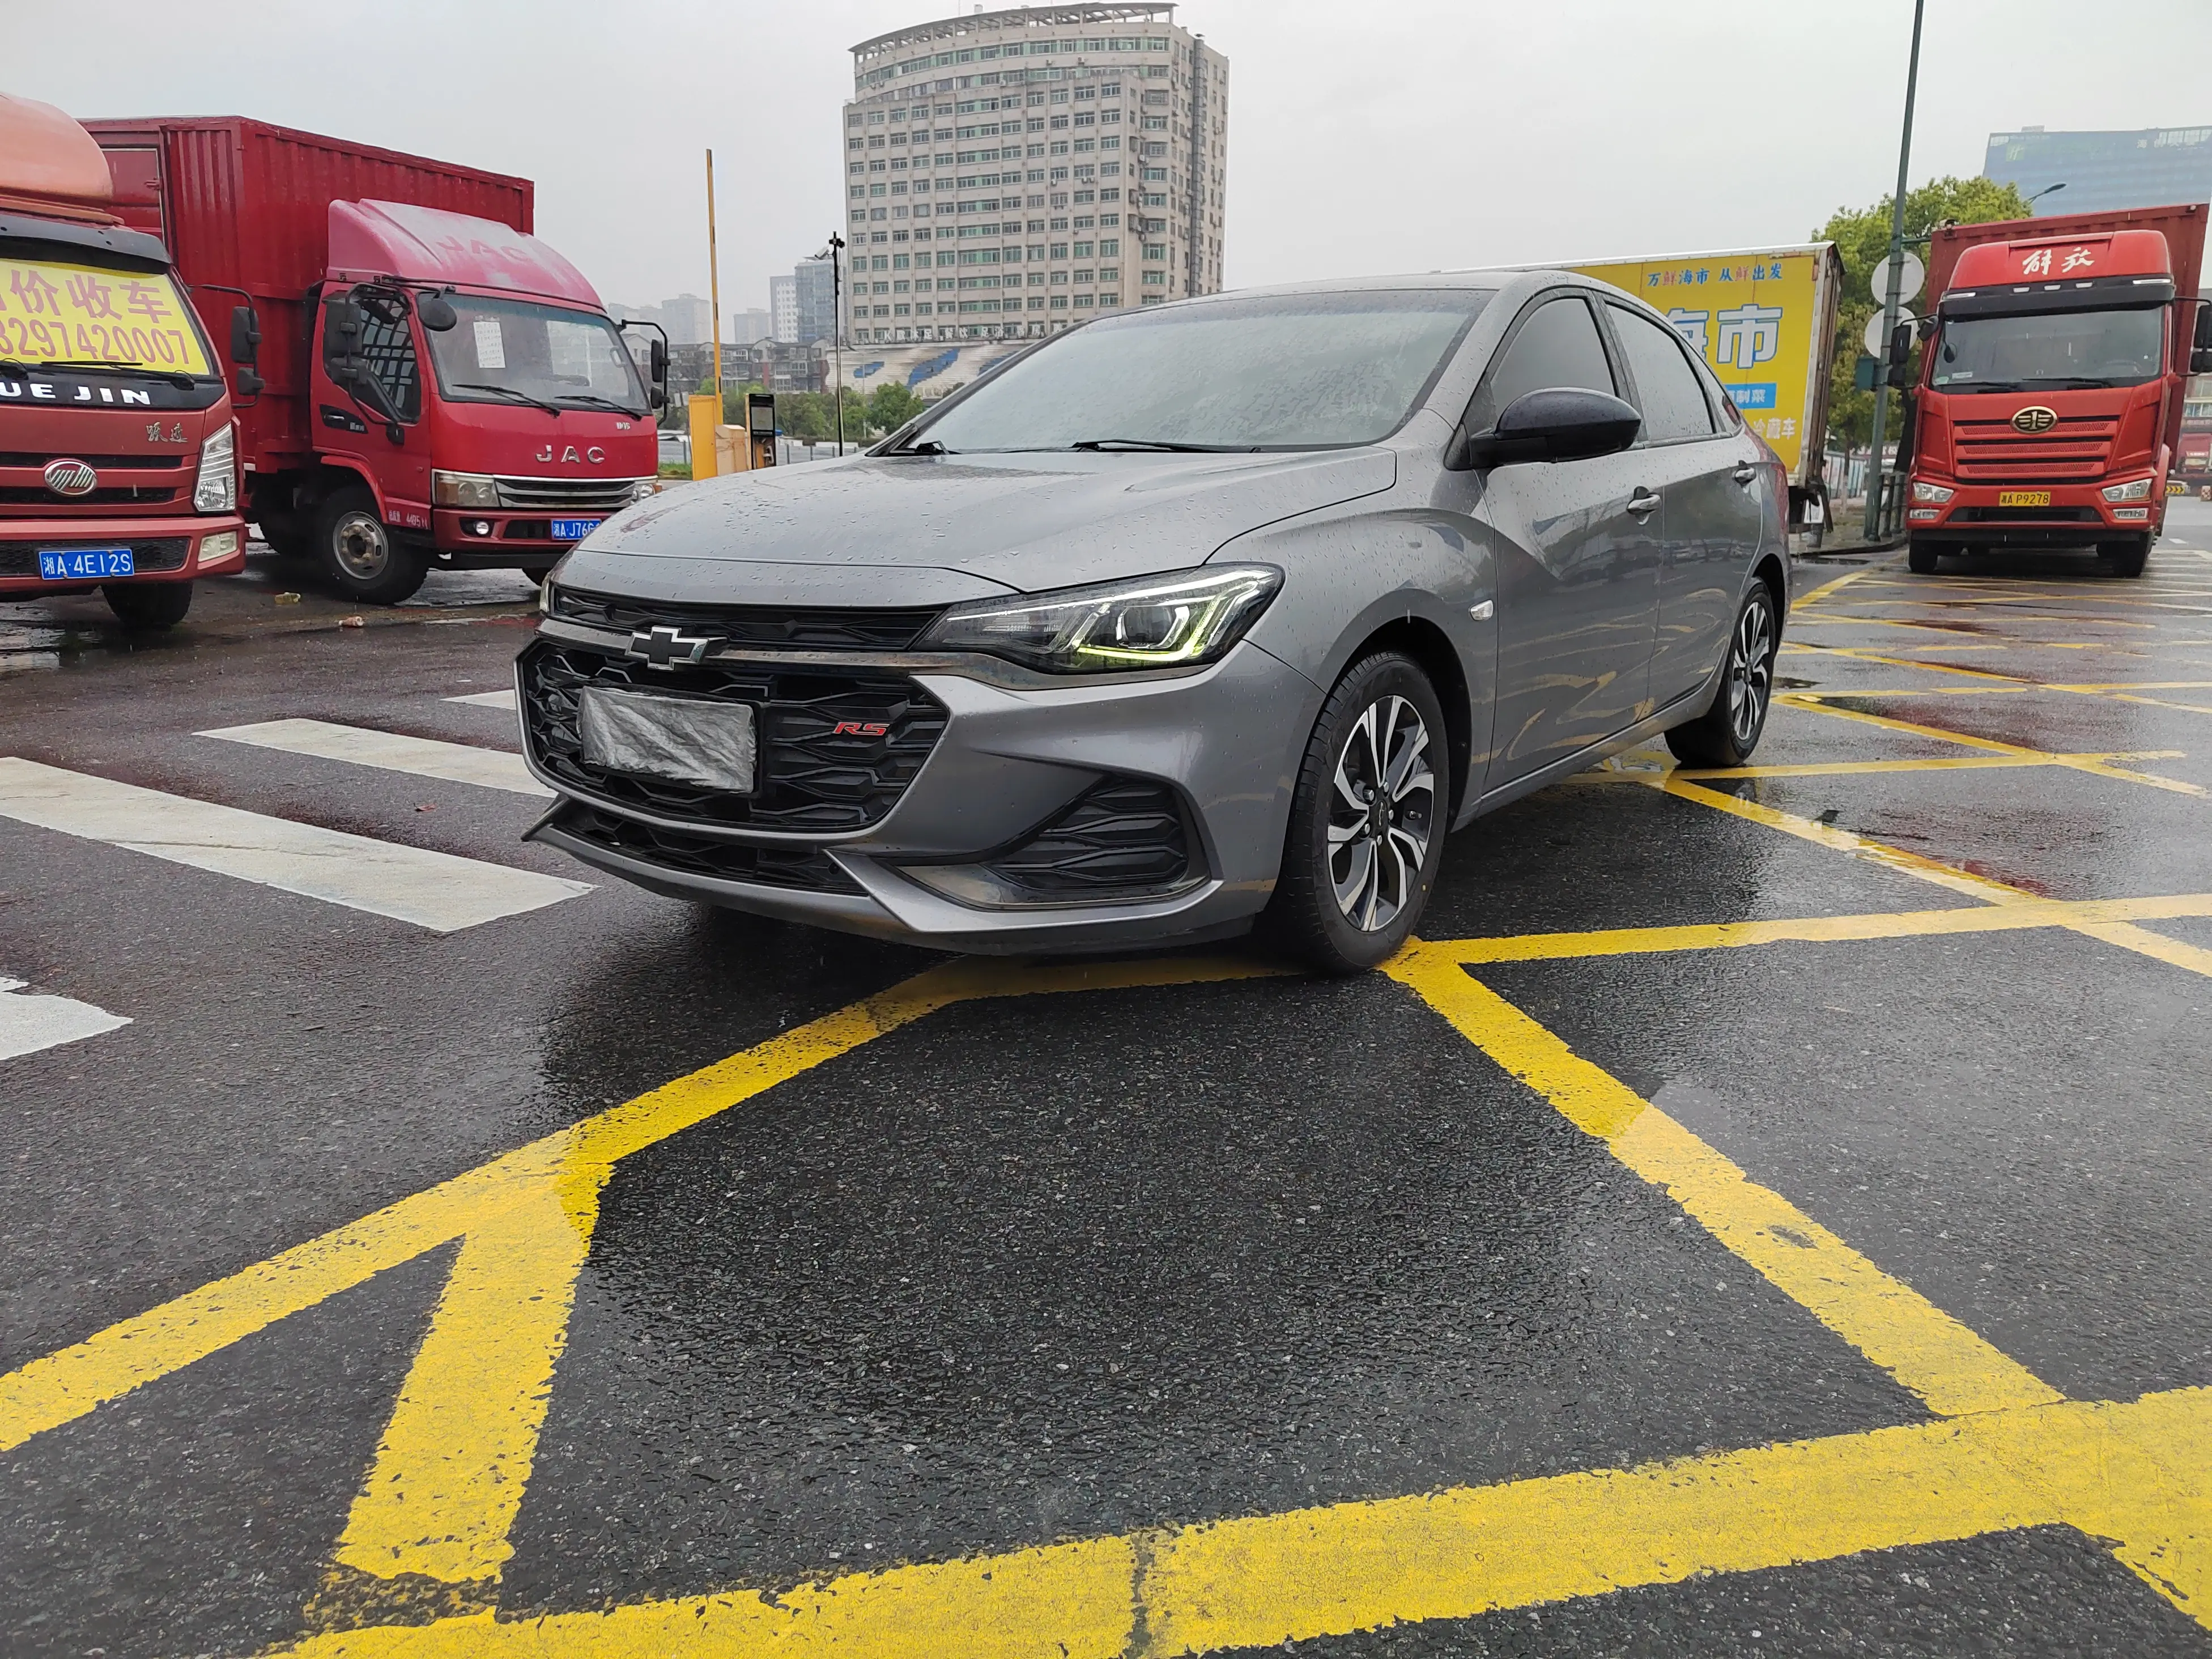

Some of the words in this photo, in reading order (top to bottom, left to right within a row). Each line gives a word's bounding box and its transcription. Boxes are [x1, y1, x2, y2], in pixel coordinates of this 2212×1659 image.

[435, 235, 534, 263] JAC
[2022, 246, 2095, 275] 解放
[1647, 267, 1710, 287] 万鲜海市
[1719, 263, 1783, 282] 从鲜出发
[0, 269, 172, 324] 价收车
[535, 445, 606, 464] JAC
[832, 721, 890, 736] RS
